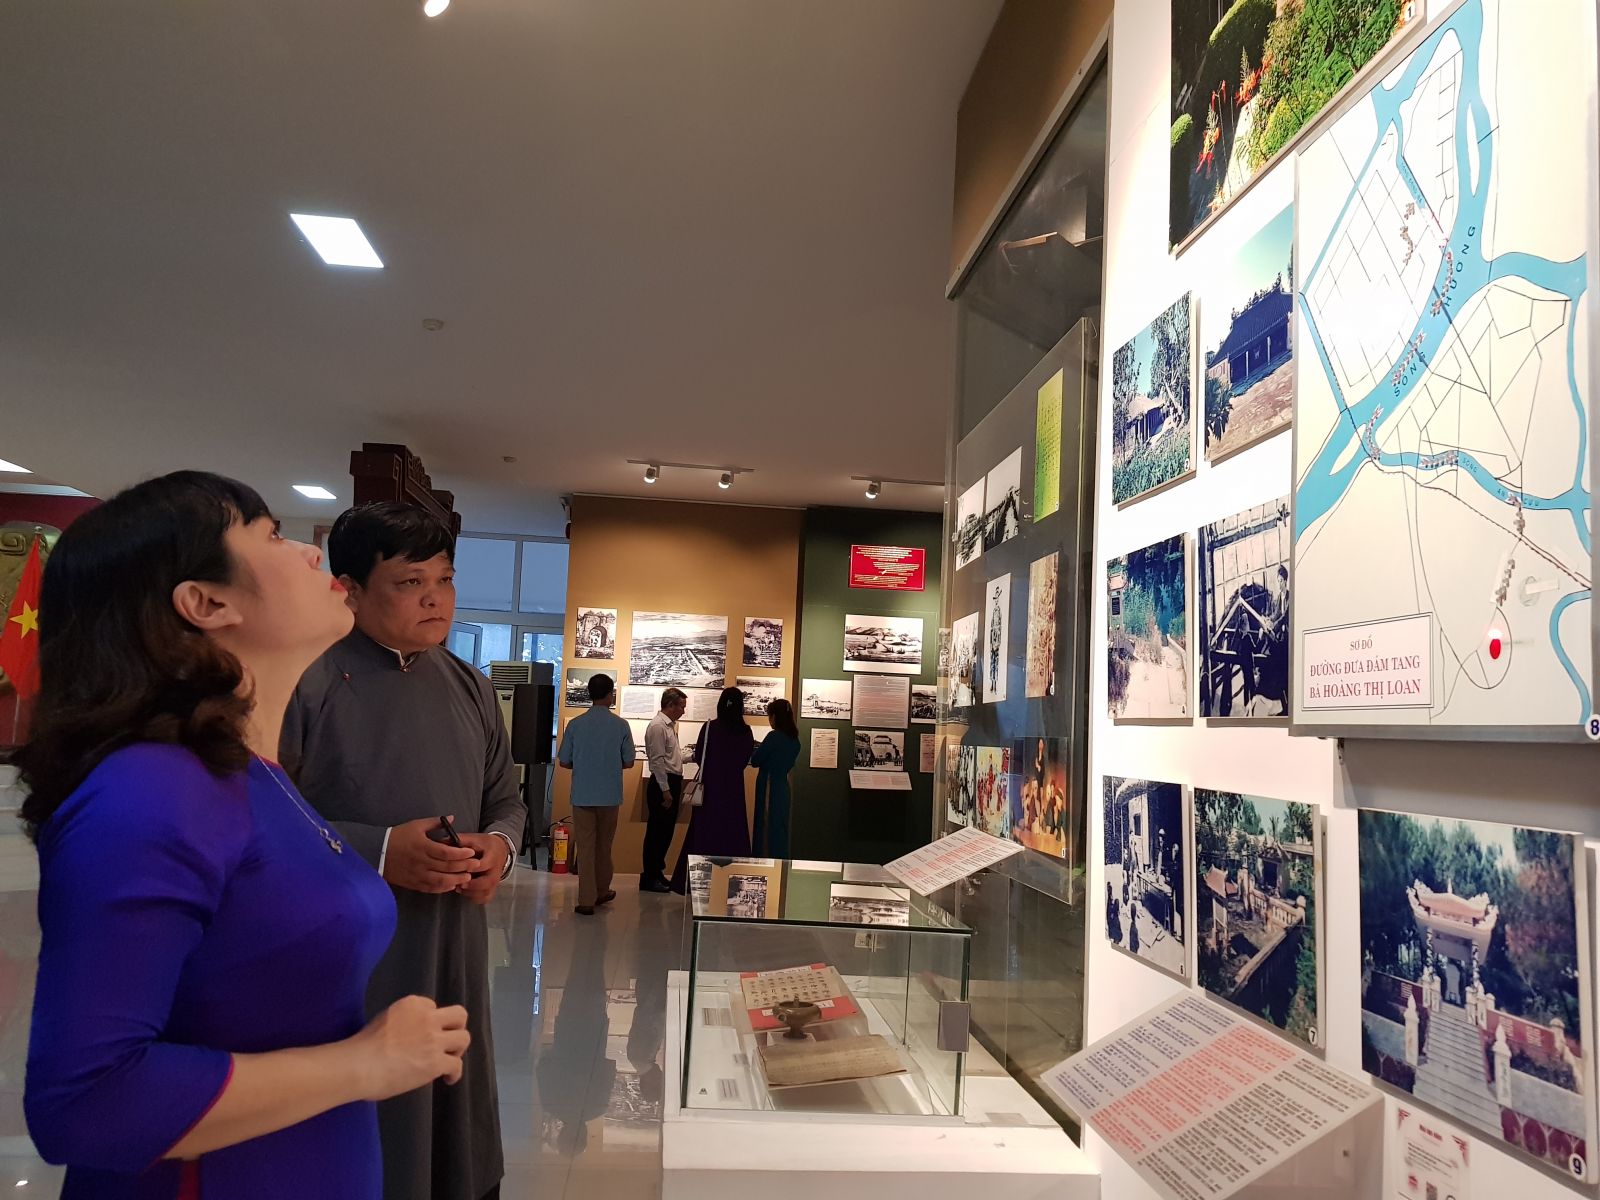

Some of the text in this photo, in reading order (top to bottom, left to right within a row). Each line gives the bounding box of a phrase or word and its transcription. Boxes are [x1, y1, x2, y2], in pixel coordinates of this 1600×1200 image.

[1407, 6, 1412, 18] 1
[1391, 655, 1421, 670] TANG
[1323, 679, 1361, 698] HOÀNG
[1363, 681, 1384, 700] THỊ
[1387, 678, 1422, 695] LOAN
[1590, 718, 1600, 736] 8
[1310, 1029, 1316, 1043] 7
[1572, 1157, 1583, 1176] 9
